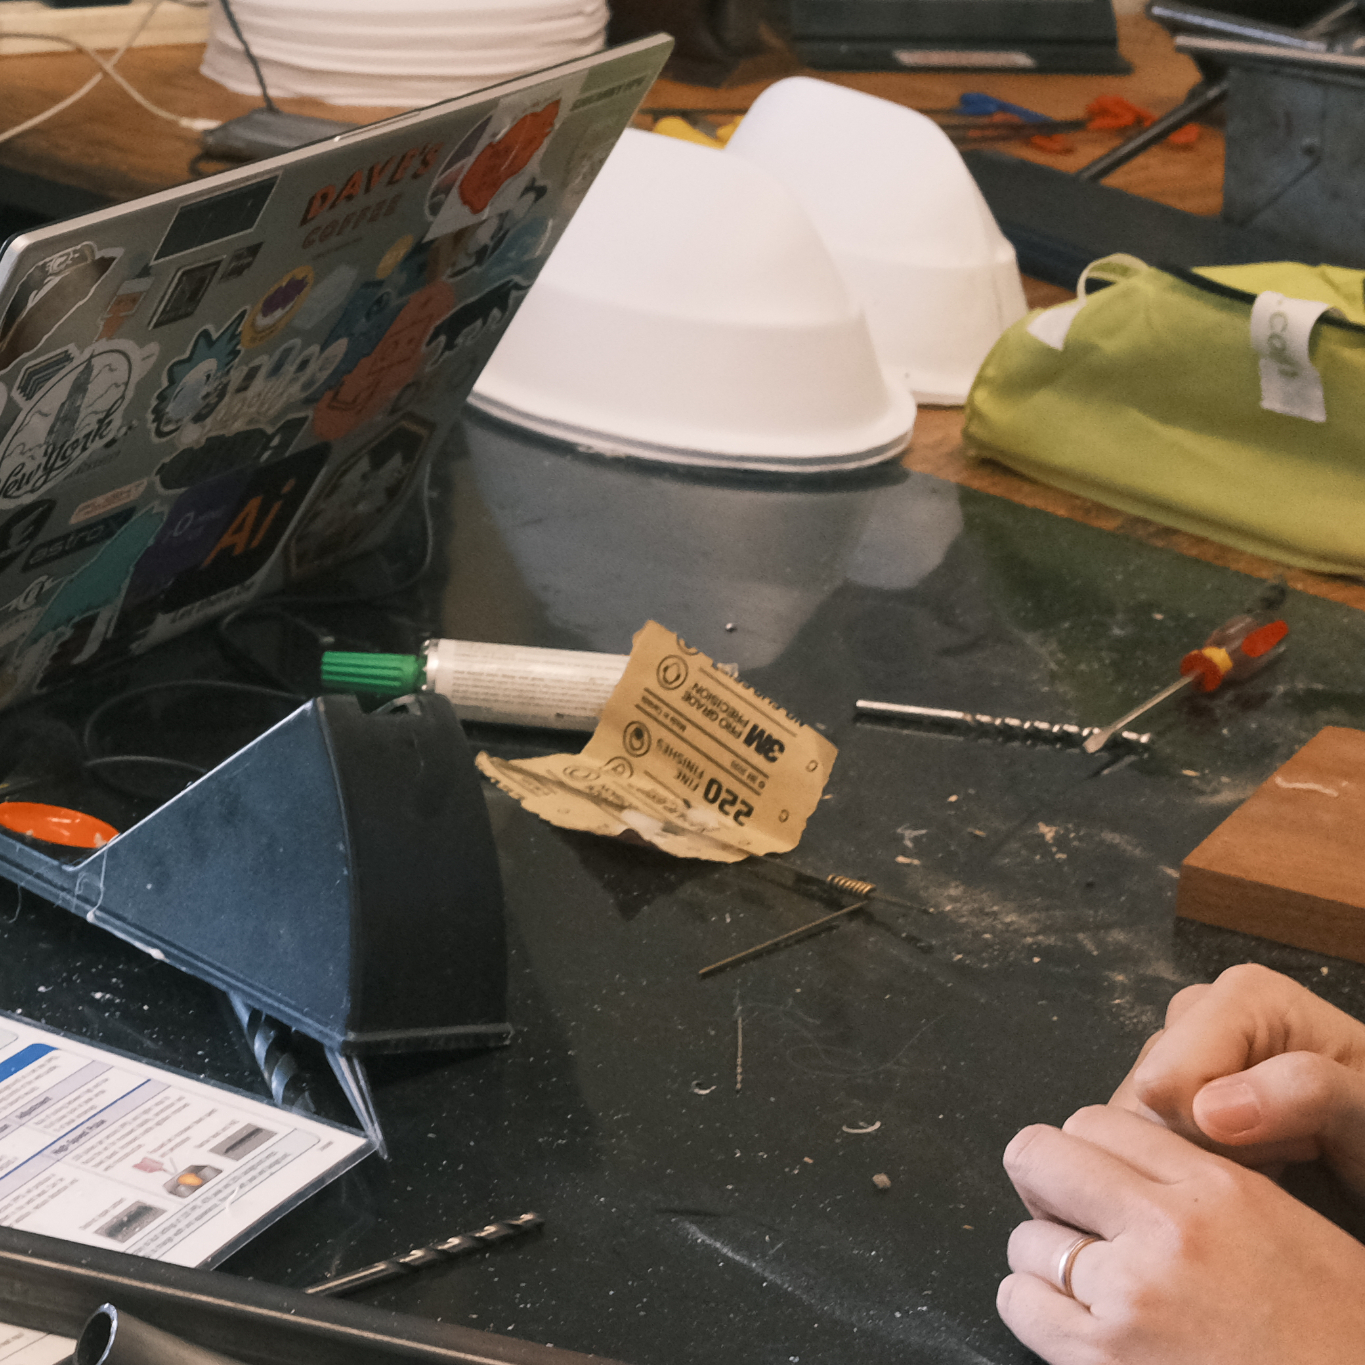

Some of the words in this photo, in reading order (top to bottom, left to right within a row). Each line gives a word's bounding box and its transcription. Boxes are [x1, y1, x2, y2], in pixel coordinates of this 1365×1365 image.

[299, 142, 444, 227] DAVE'S
[302, 192, 403, 249] COFFEE
[201, 478, 296, 569] Ai
[681, 690, 719, 721] GRADE
[689, 682, 749, 728] PRECISION
[718, 717, 743, 738] PRO
[743, 724, 785, 763] 3M
[656, 738, 705, 780] FINISHES
[675, 768, 700, 792] FINE
[703, 777, 754, 826] 220
